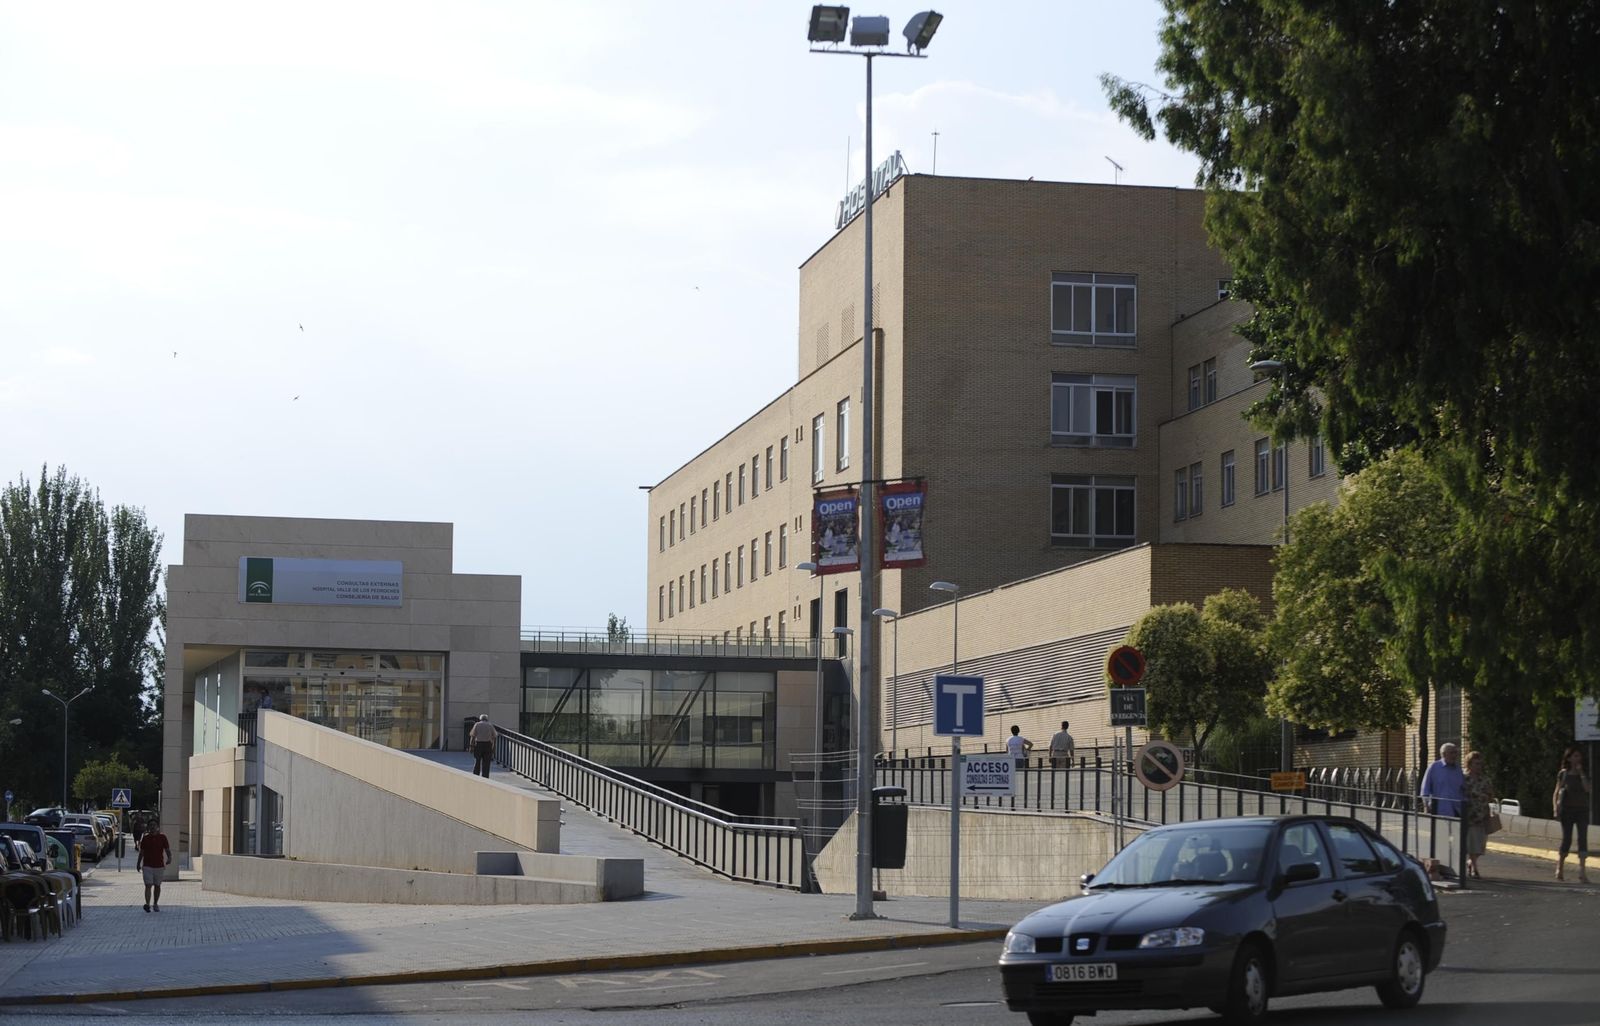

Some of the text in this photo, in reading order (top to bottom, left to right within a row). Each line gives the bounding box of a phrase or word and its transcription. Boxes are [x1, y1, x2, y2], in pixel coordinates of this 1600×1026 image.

[835, 149, 903, 229] HOSITAL
[820, 501, 853, 515] Open
[886, 496, 920, 510] Open
[966, 762, 1009, 773] ACCESO
[988, 774, 1009, 785] EXTERNAS
[1055, 966, 1086, 980] 0816
